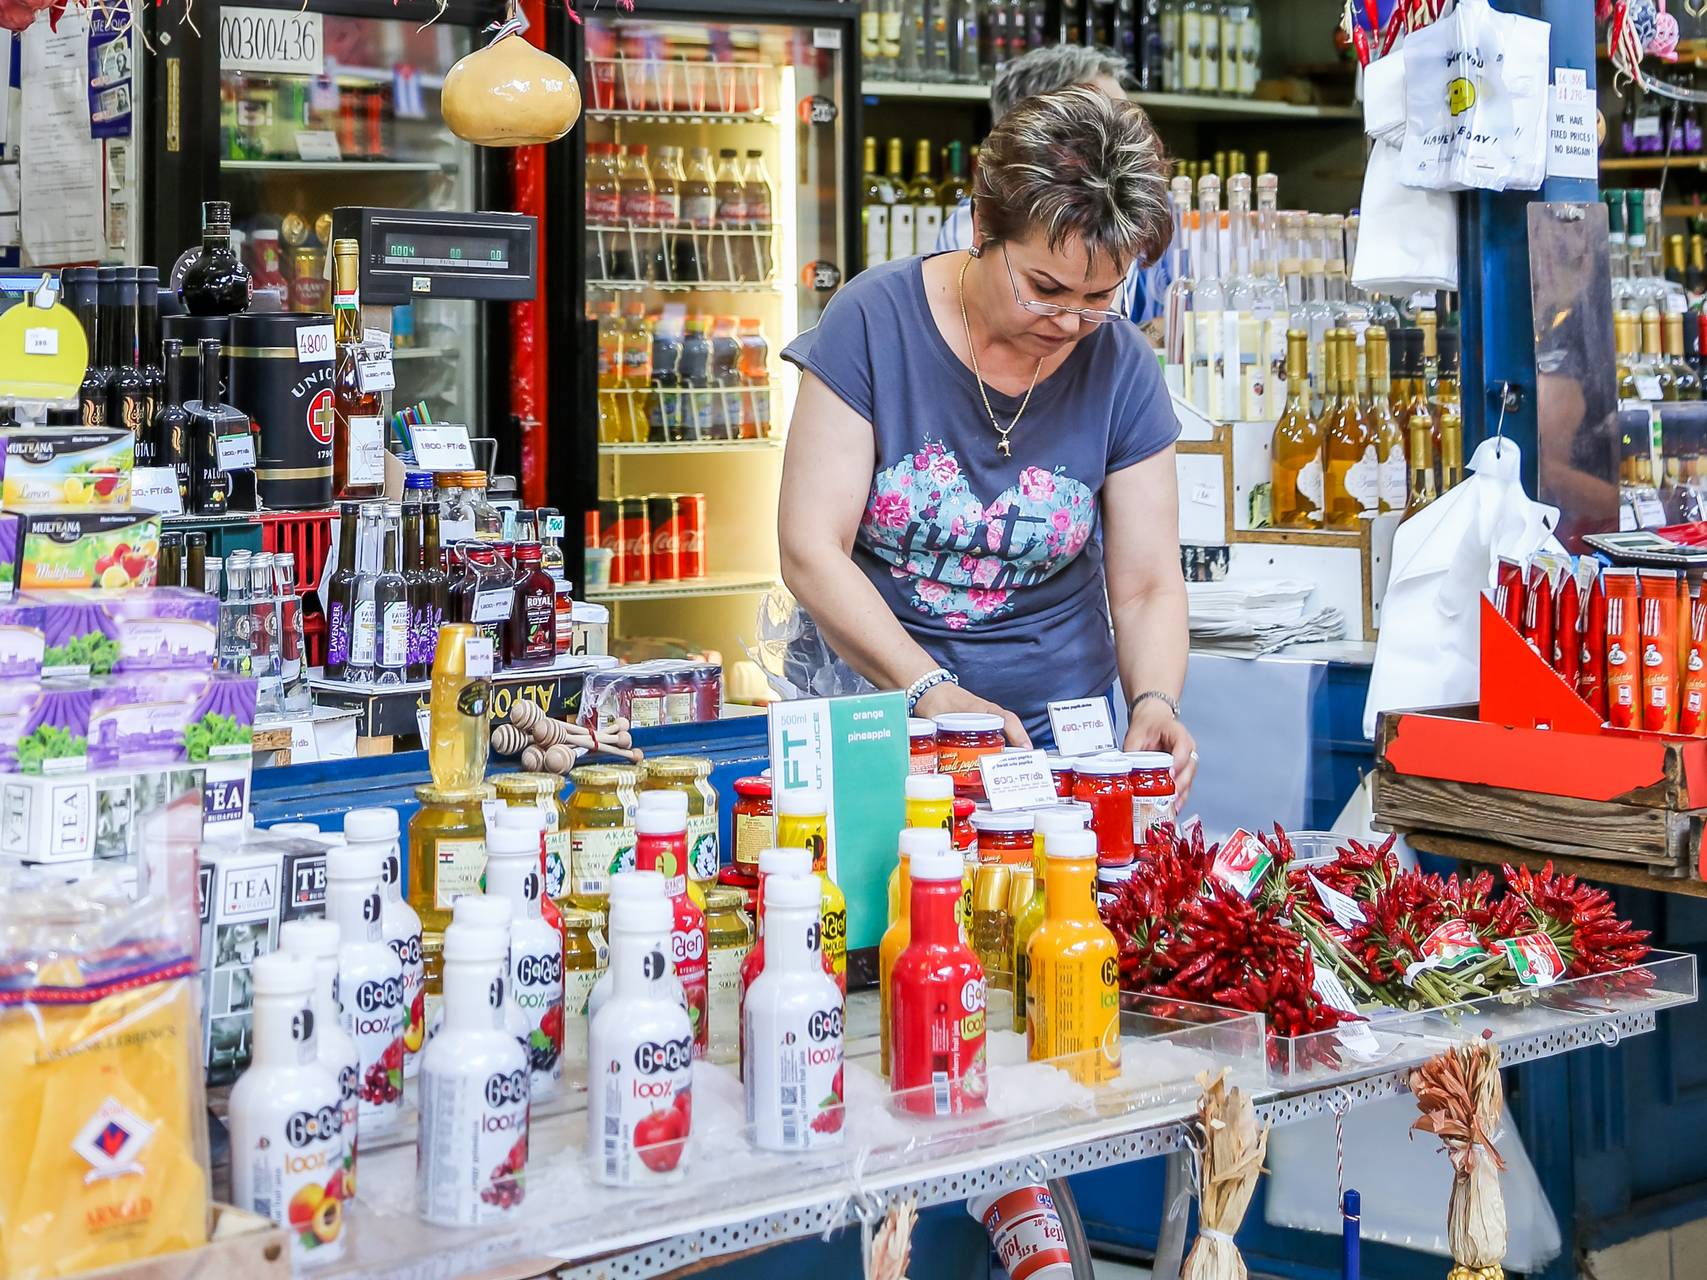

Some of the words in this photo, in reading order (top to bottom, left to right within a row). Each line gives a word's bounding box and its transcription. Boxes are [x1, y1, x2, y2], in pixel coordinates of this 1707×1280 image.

[220, 16, 315, 62] 00300436
[1555, 113, 1565, 124] WE
[1569, 115, 1583, 126] HAVE
[1550, 129, 1567, 140] FIXED
[1554, 144, 1563, 154] NO
[300, 334, 328, 354] 4800
[291, 367, 336, 398] UNIC
[32, 521, 81, 533] MULTEANA
[548, 519, 563, 532] 500
[527, 596, 553, 608] ROYAL
[329, 605, 341, 652] LAVENDER
[780, 713, 807, 726] 500ml
[853, 709, 884, 721] orange
[813, 711, 822, 760] JUICE
[847, 729, 891, 744] pineapple
[61, 792, 78, 849] TEA
[229, 878, 271, 900] TEA
[298, 867, 326, 891] TE
[514, 990, 545, 1008] 100%
[355, 1016, 391, 1036] 100%
[807, 1046, 837, 1066] 100%
[633, 1079, 673, 1099] 100%
[482, 1111, 517, 1134] 100%
[285, 1152, 327, 1176] 100%
